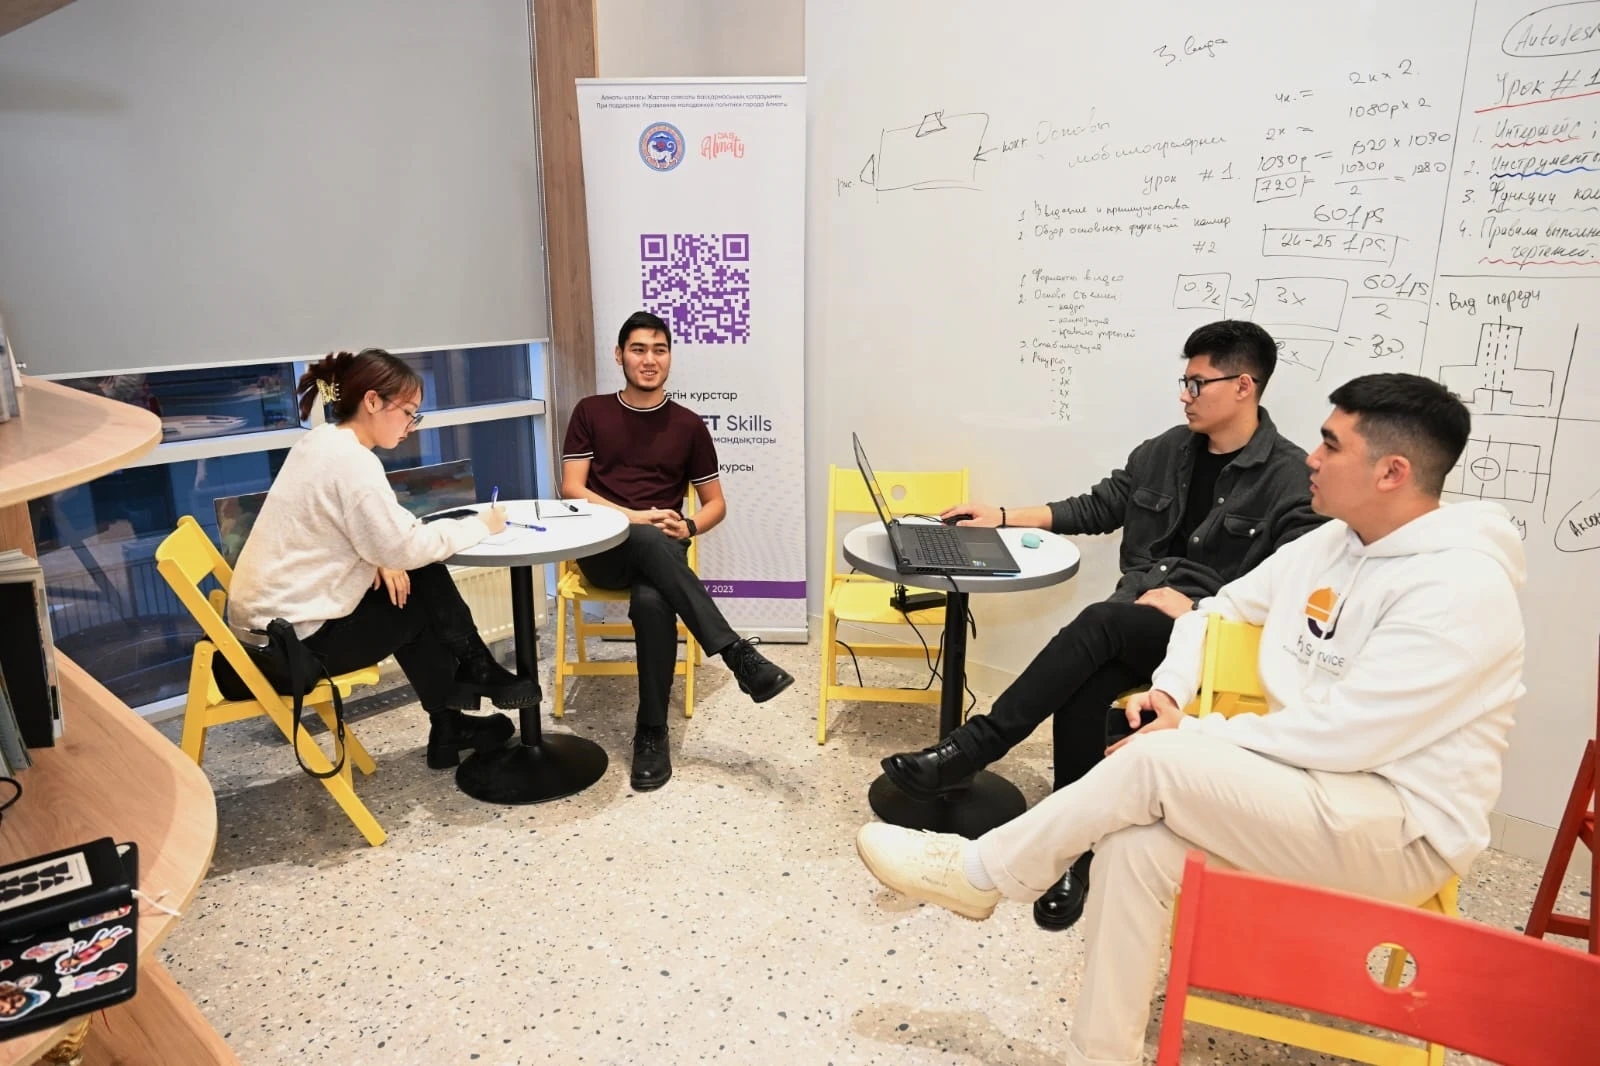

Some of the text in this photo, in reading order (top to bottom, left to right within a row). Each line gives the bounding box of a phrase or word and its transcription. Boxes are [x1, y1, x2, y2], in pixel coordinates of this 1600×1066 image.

[700, 133, 745, 160] Almaty
[1449, 289, 1541, 316] Вид спереди
[663, 389, 738, 401] егін курстар
[726, 415, 773, 432] Skills
[711, 435, 777, 445] мандықтары
[719, 462, 754, 472] курсы
[712, 585, 734, 593] 2023
